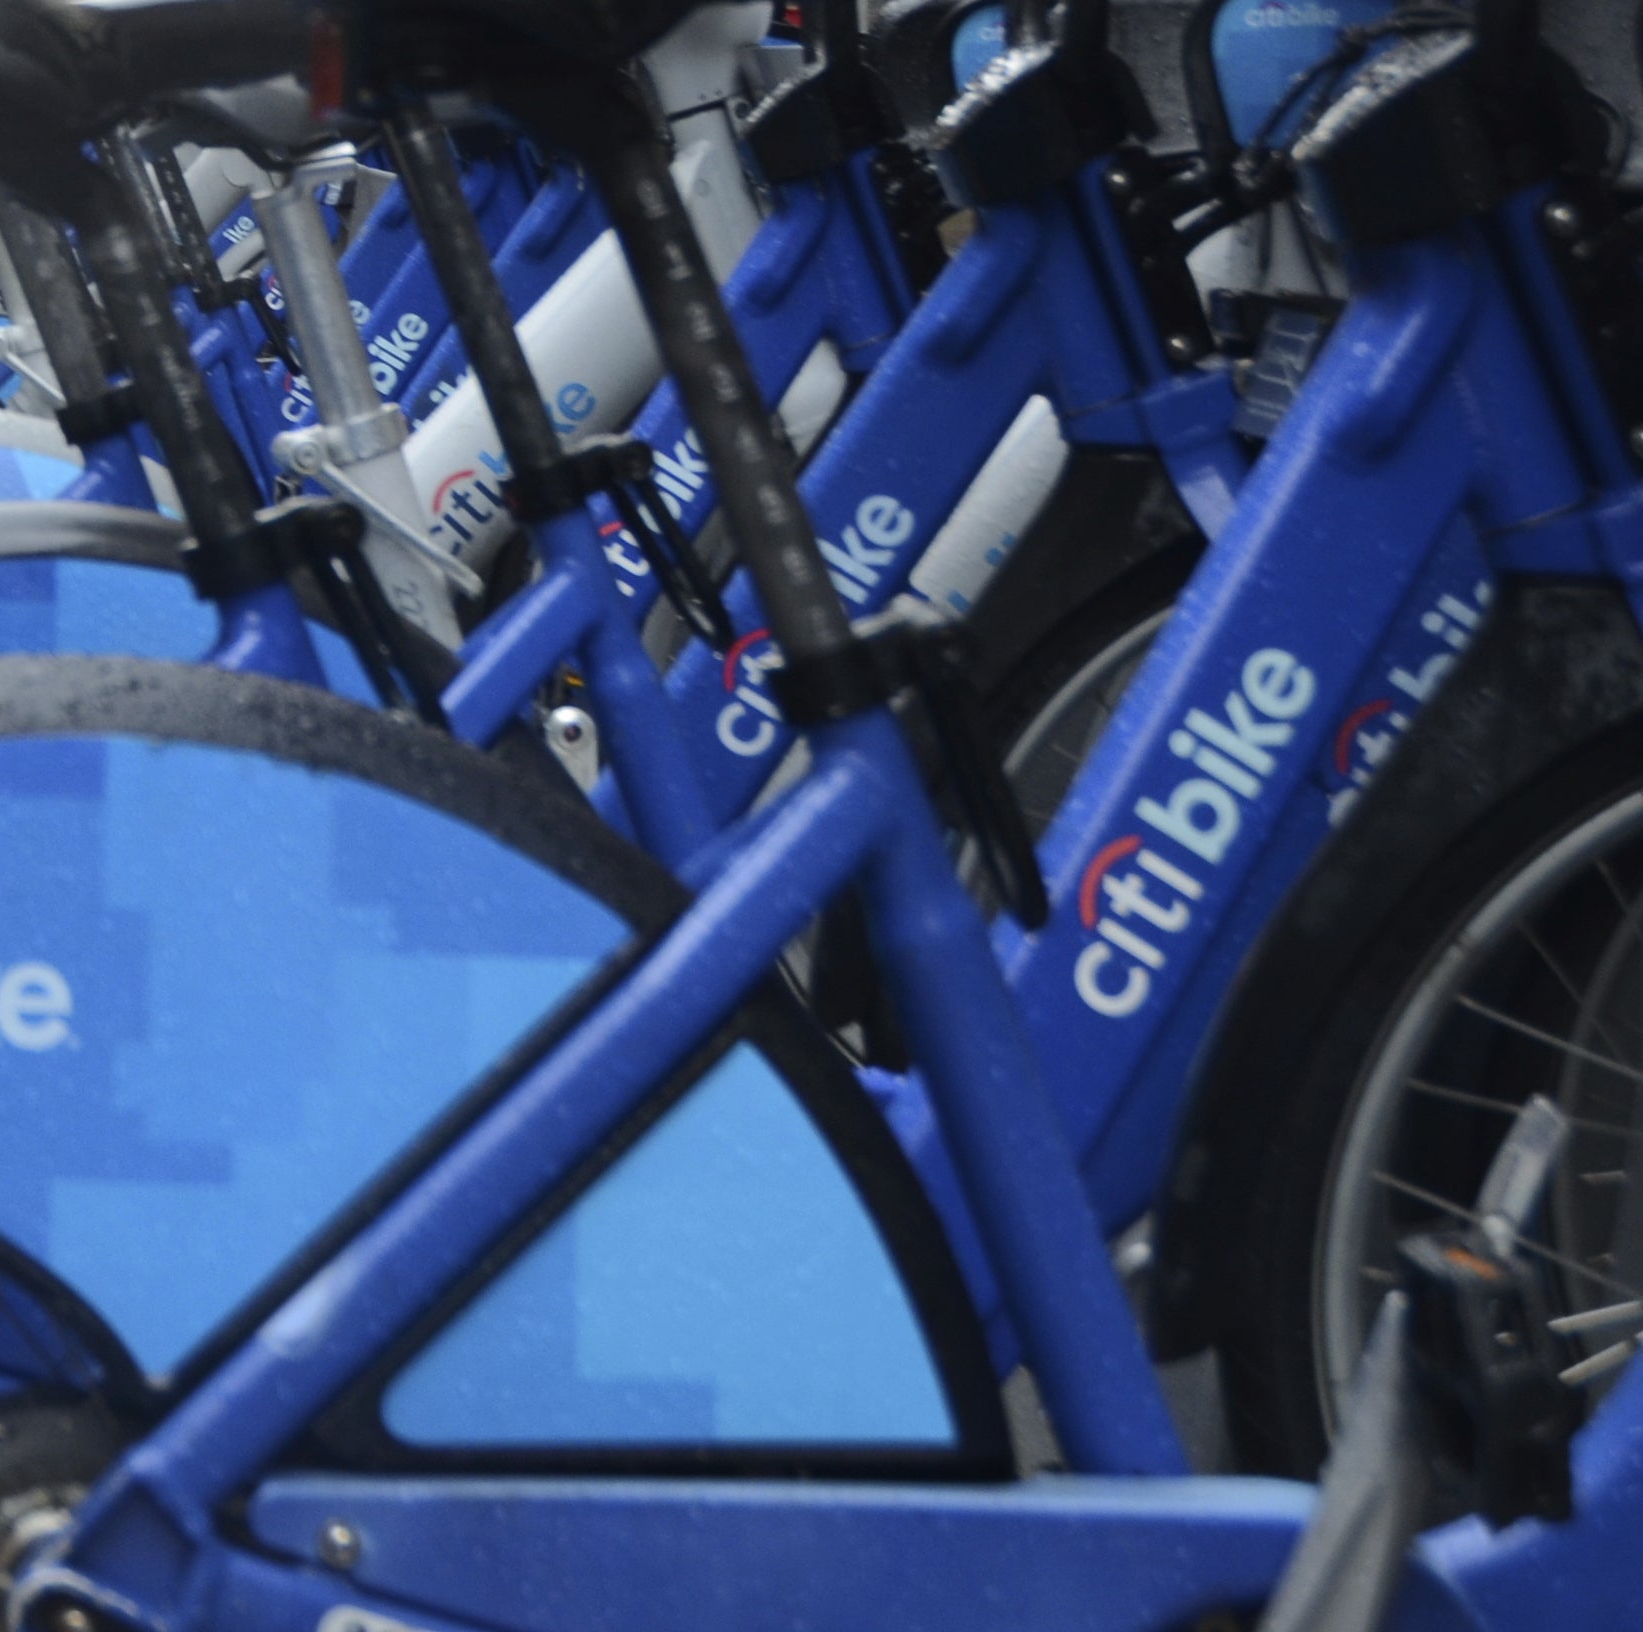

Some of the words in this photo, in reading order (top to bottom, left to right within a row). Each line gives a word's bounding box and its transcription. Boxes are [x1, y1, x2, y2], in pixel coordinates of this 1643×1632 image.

[222, 215, 256, 245] ike
[1132, 646, 1317, 865] bike
[1073, 835, 1206, 1019] citi
